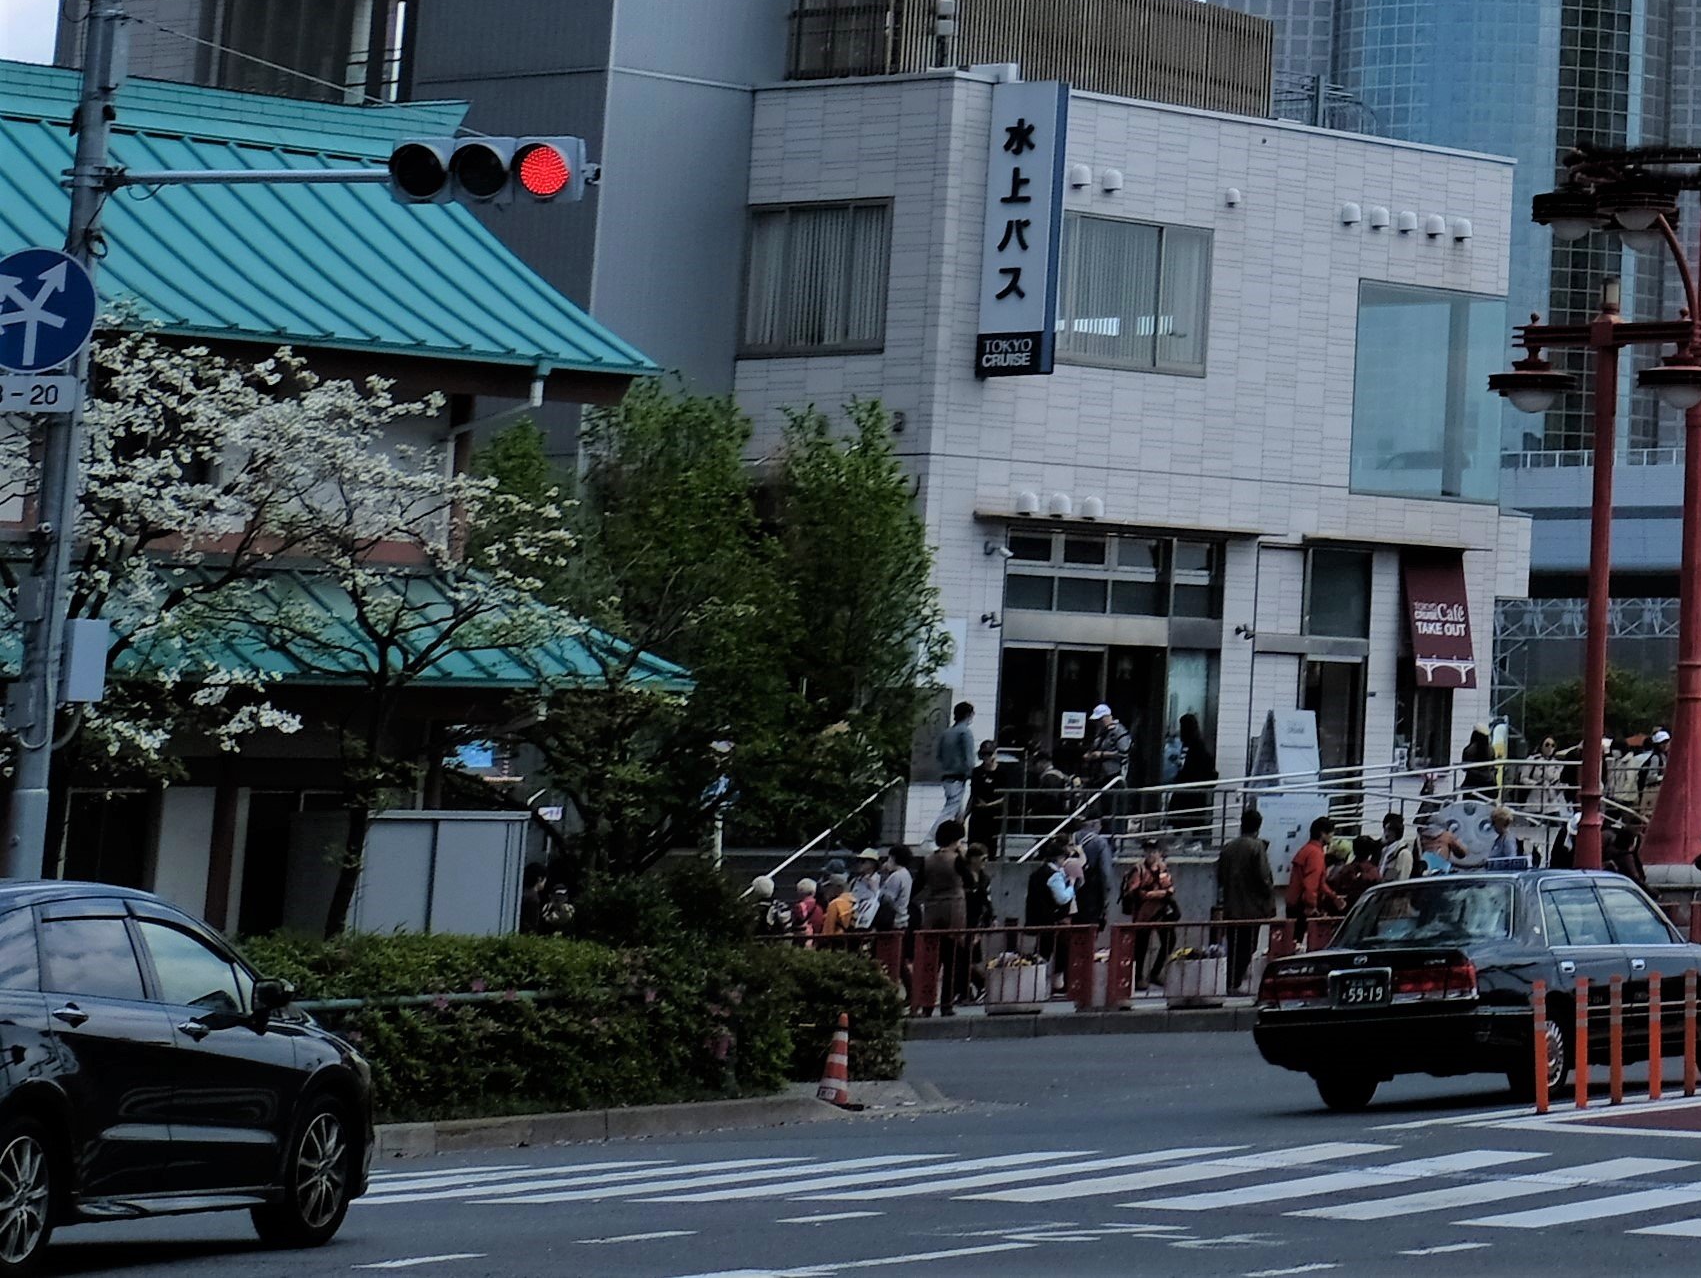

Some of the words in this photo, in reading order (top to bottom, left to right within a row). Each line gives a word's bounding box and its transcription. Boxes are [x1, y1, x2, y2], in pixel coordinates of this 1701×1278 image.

[995, 118, 1035, 300] 水上バス
[982, 339, 1032, 354] TOKYO
[981, 353, 1031, 368] CRUISE
[1415, 621, 1443, 635] TAKE
[1443, 623, 1466, 637] OUT
[1347, 986, 1384, 1003] 59-19
